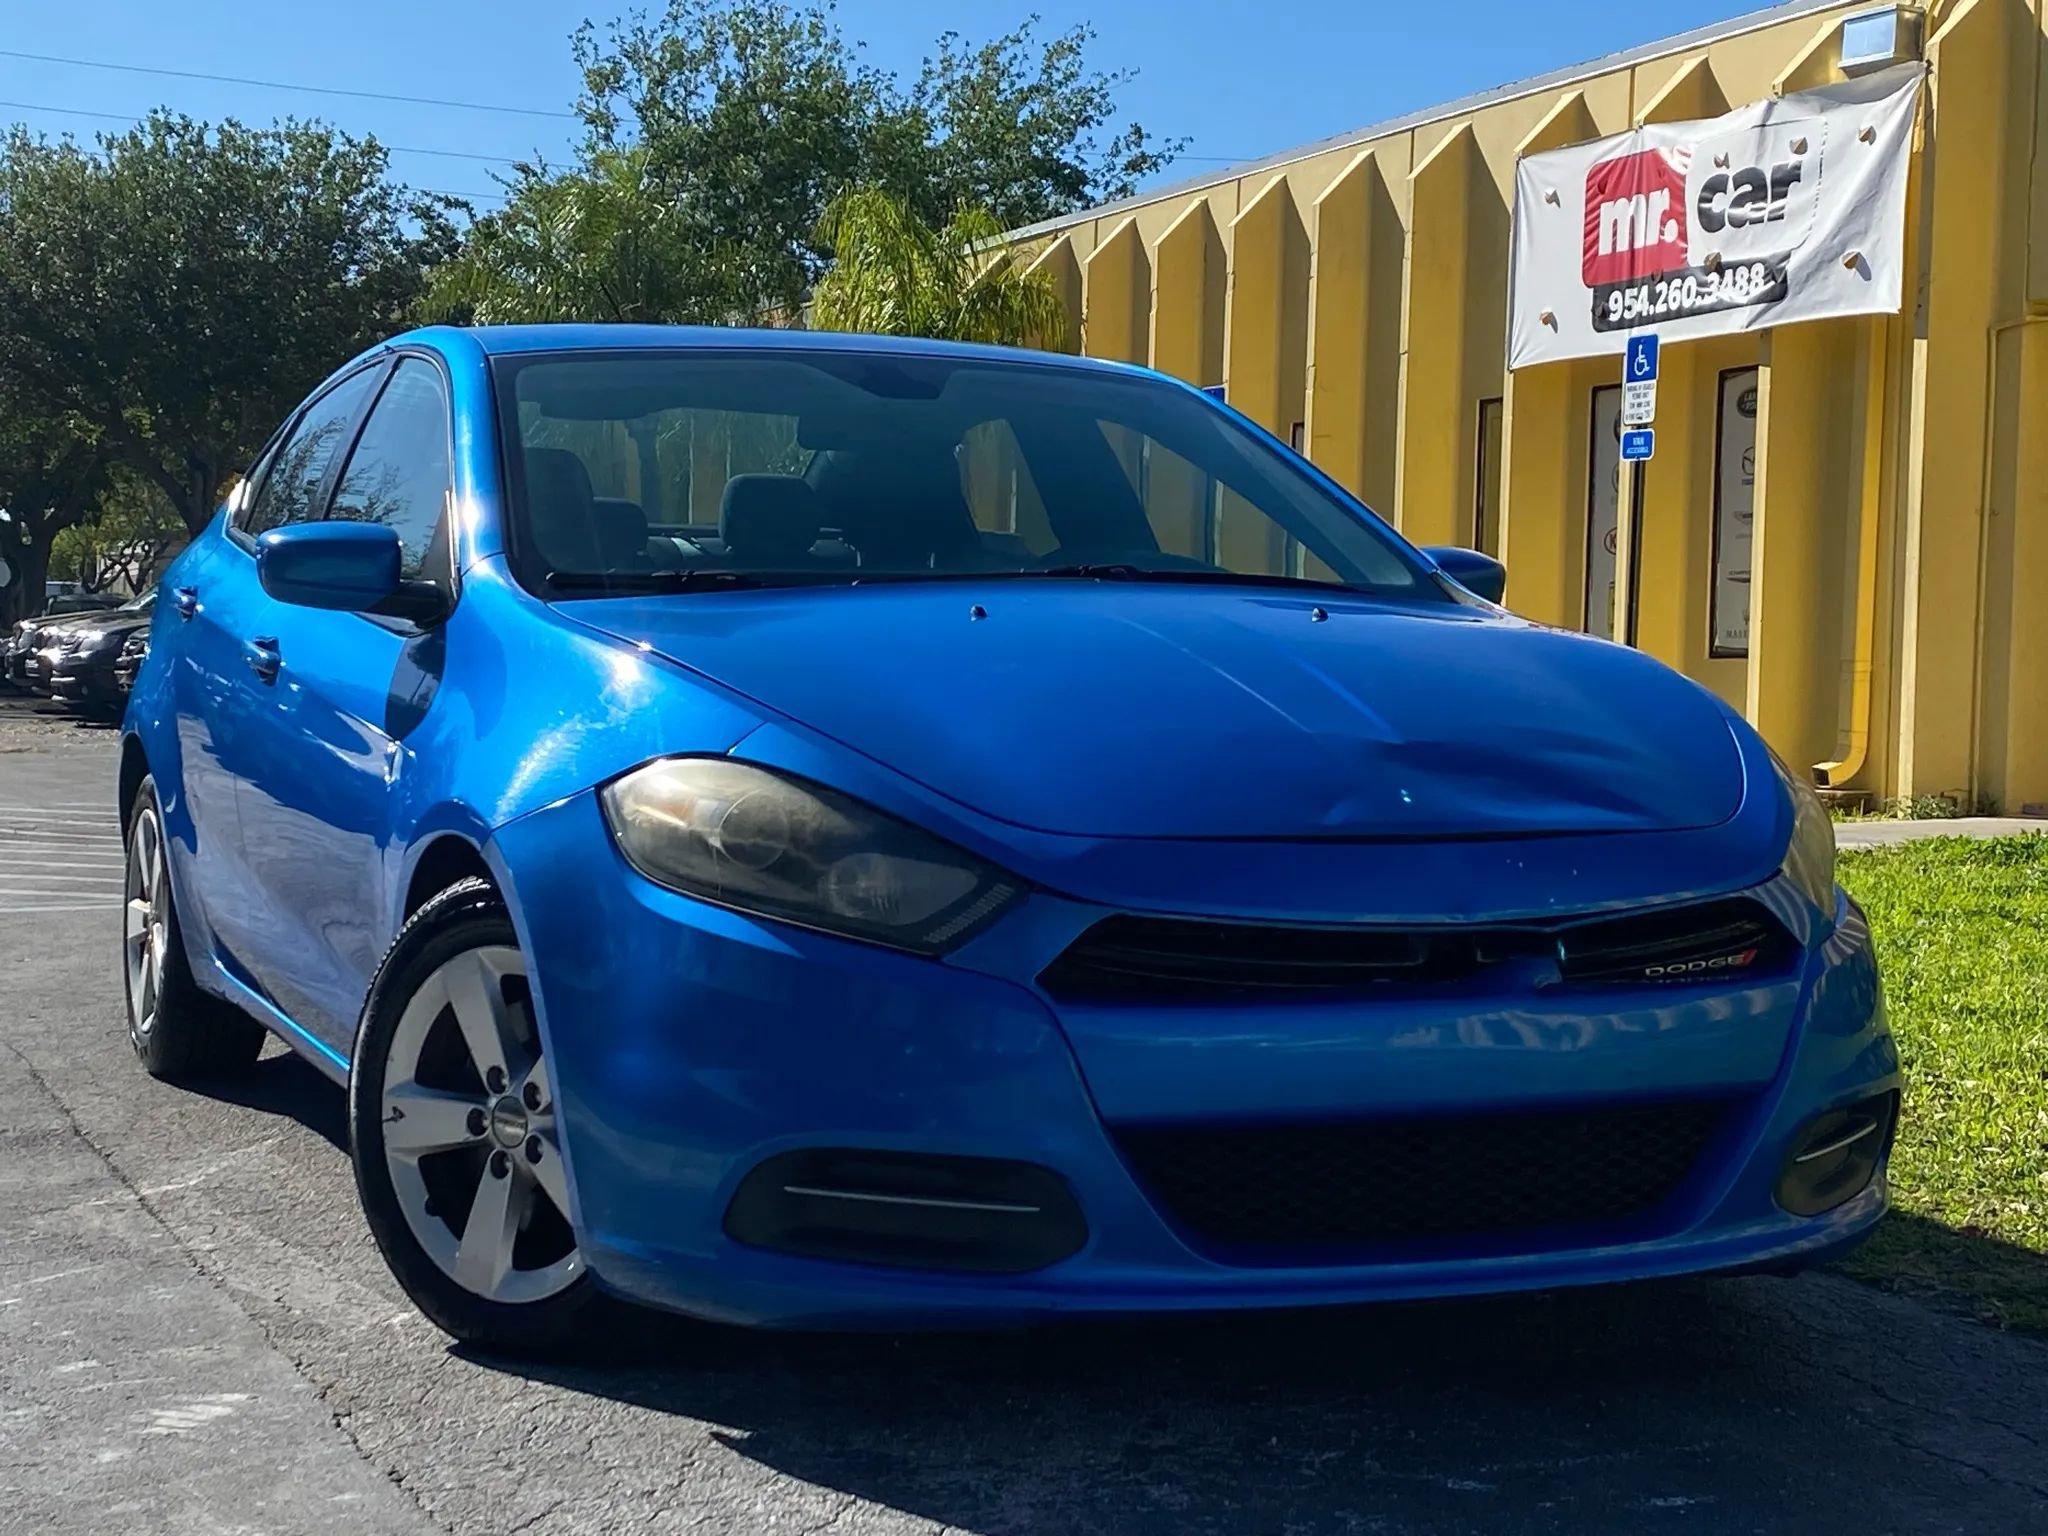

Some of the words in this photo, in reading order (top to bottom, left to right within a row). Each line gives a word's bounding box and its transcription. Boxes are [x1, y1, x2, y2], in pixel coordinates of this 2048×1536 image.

[1598, 187, 1679, 257] mr.
[1697, 160, 1801, 233] car
[1608, 262, 1766, 322] 954.260.3488
[1645, 954, 1745, 977] DODGE
